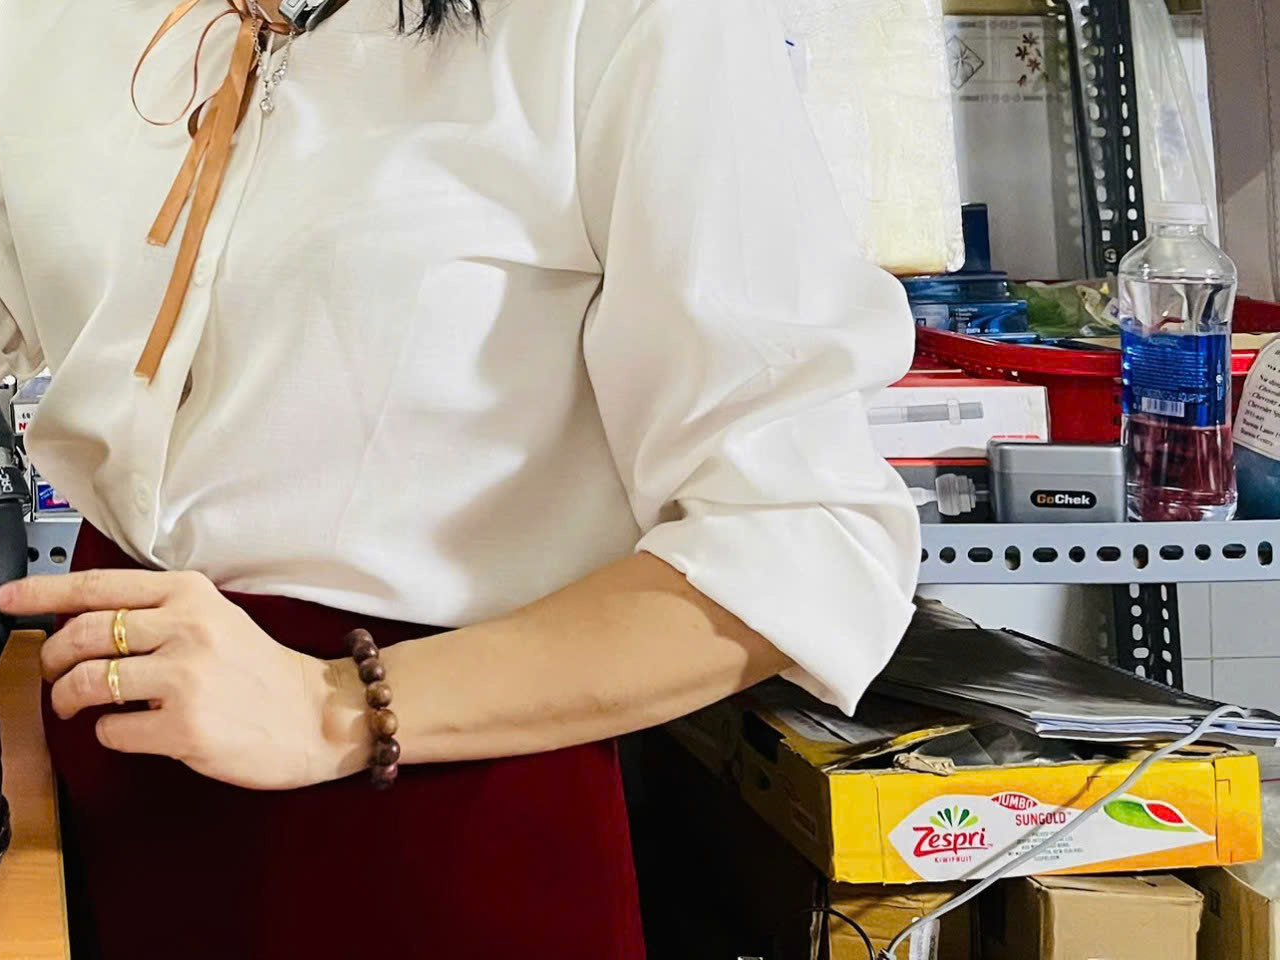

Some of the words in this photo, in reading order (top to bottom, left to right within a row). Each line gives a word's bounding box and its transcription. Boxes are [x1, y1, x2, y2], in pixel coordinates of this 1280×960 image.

[1036, 494, 1091, 506] GoChek
[997, 794, 1034, 810] JUMBO
[1015, 812, 1066, 826] SUNGOLD
[913, 827, 989, 858] Zespri
